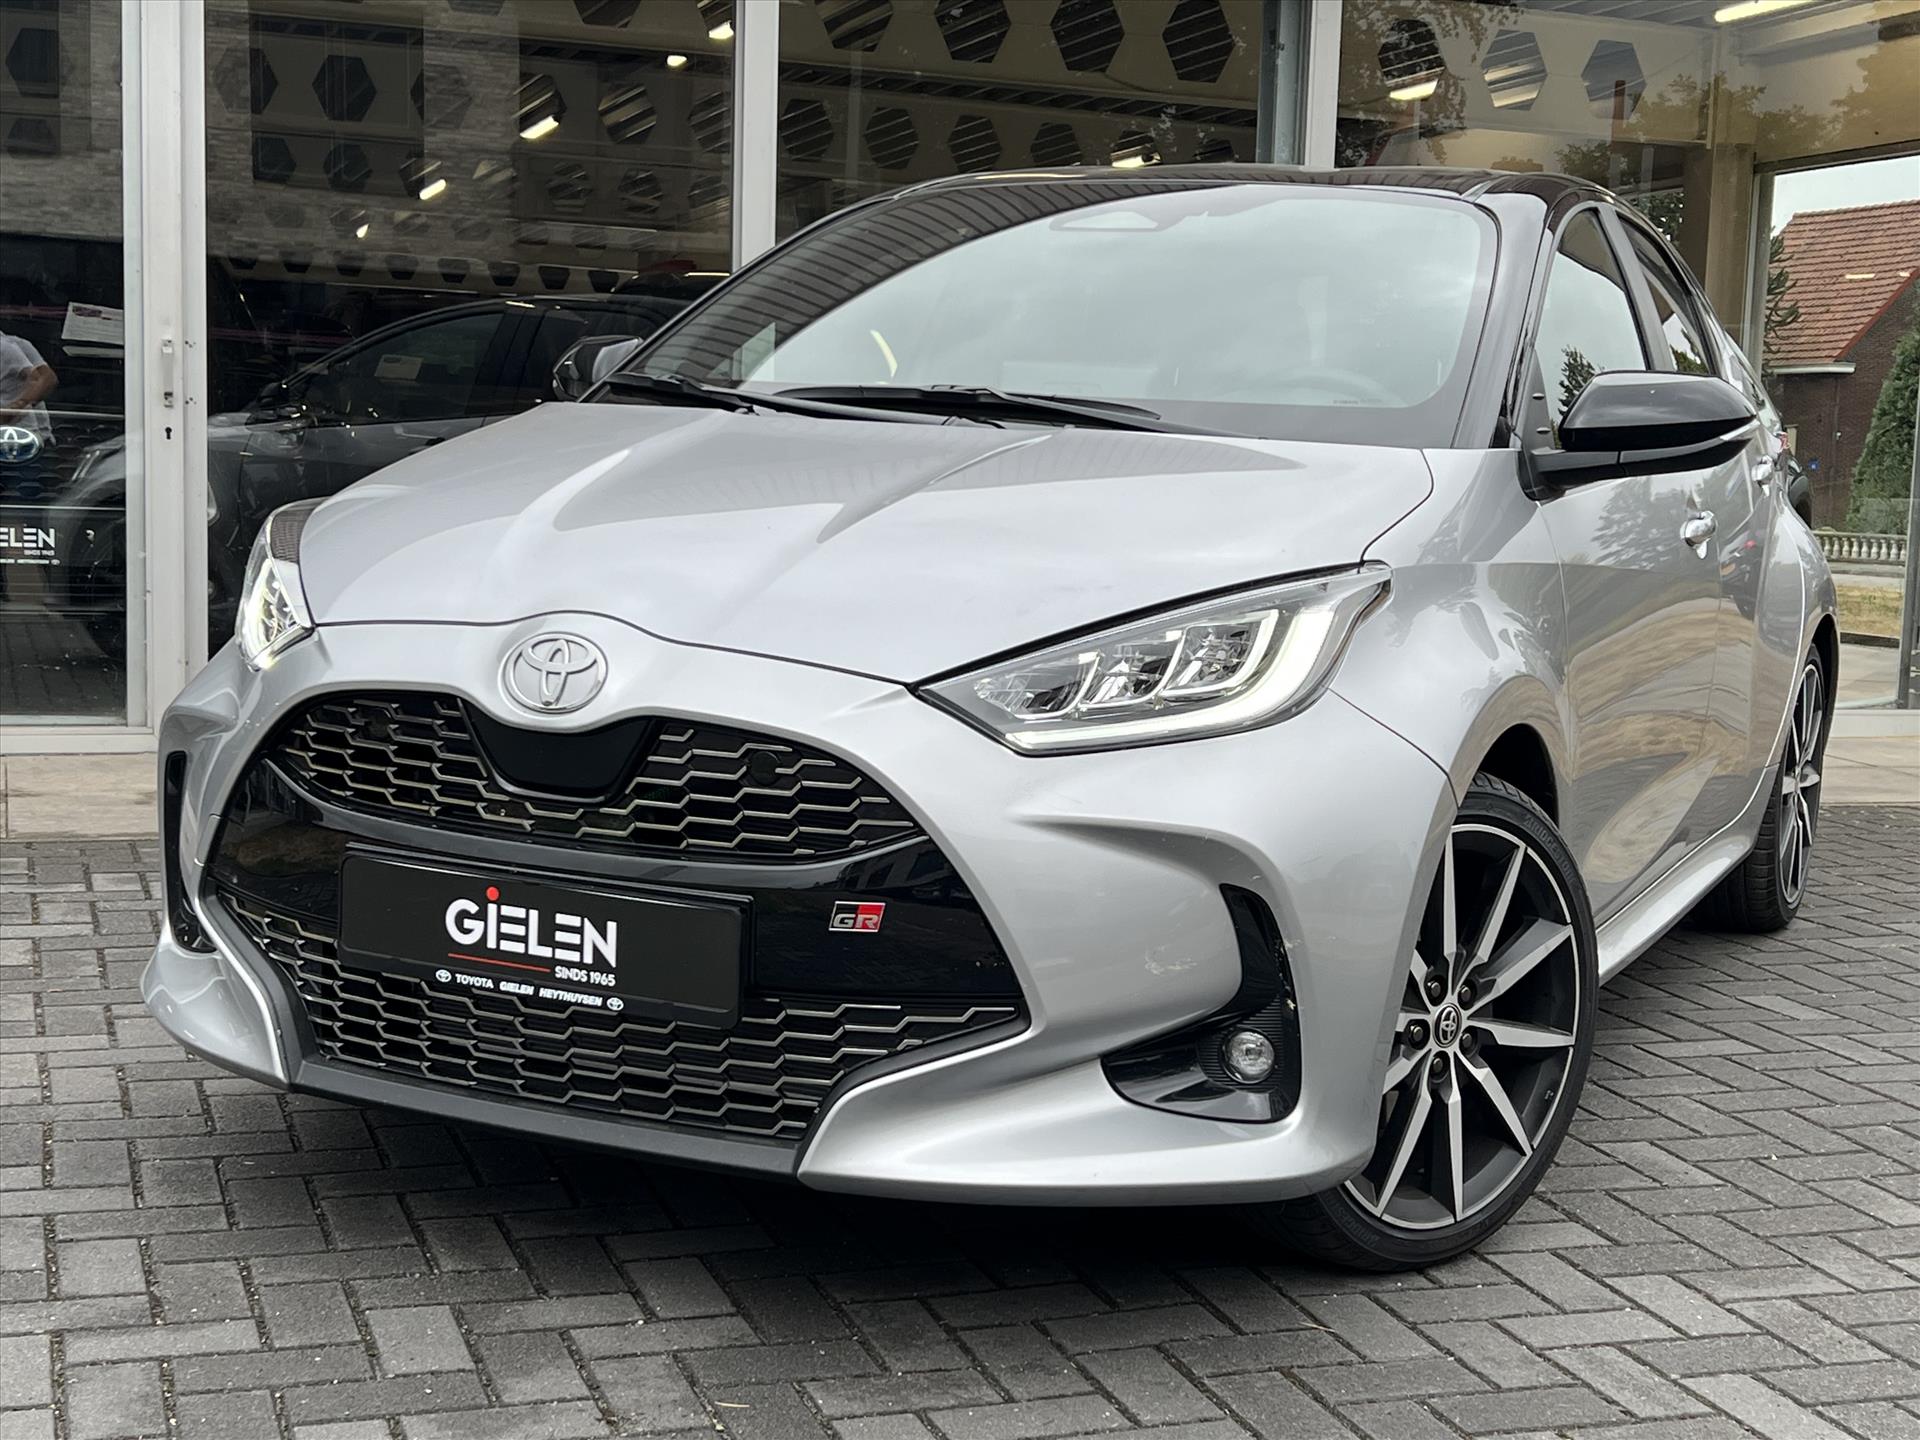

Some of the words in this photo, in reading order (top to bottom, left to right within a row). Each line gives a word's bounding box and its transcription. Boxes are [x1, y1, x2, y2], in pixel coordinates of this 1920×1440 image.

[833, 913, 879, 929] GR
[555, 966, 587, 983] SINDS
[589, 969, 616, 987] 1965
[455, 973, 494, 989] TOYOTA
[499, 981, 534, 996] GIELEN
[539, 987, 603, 1007] HEYTHUYSEN
